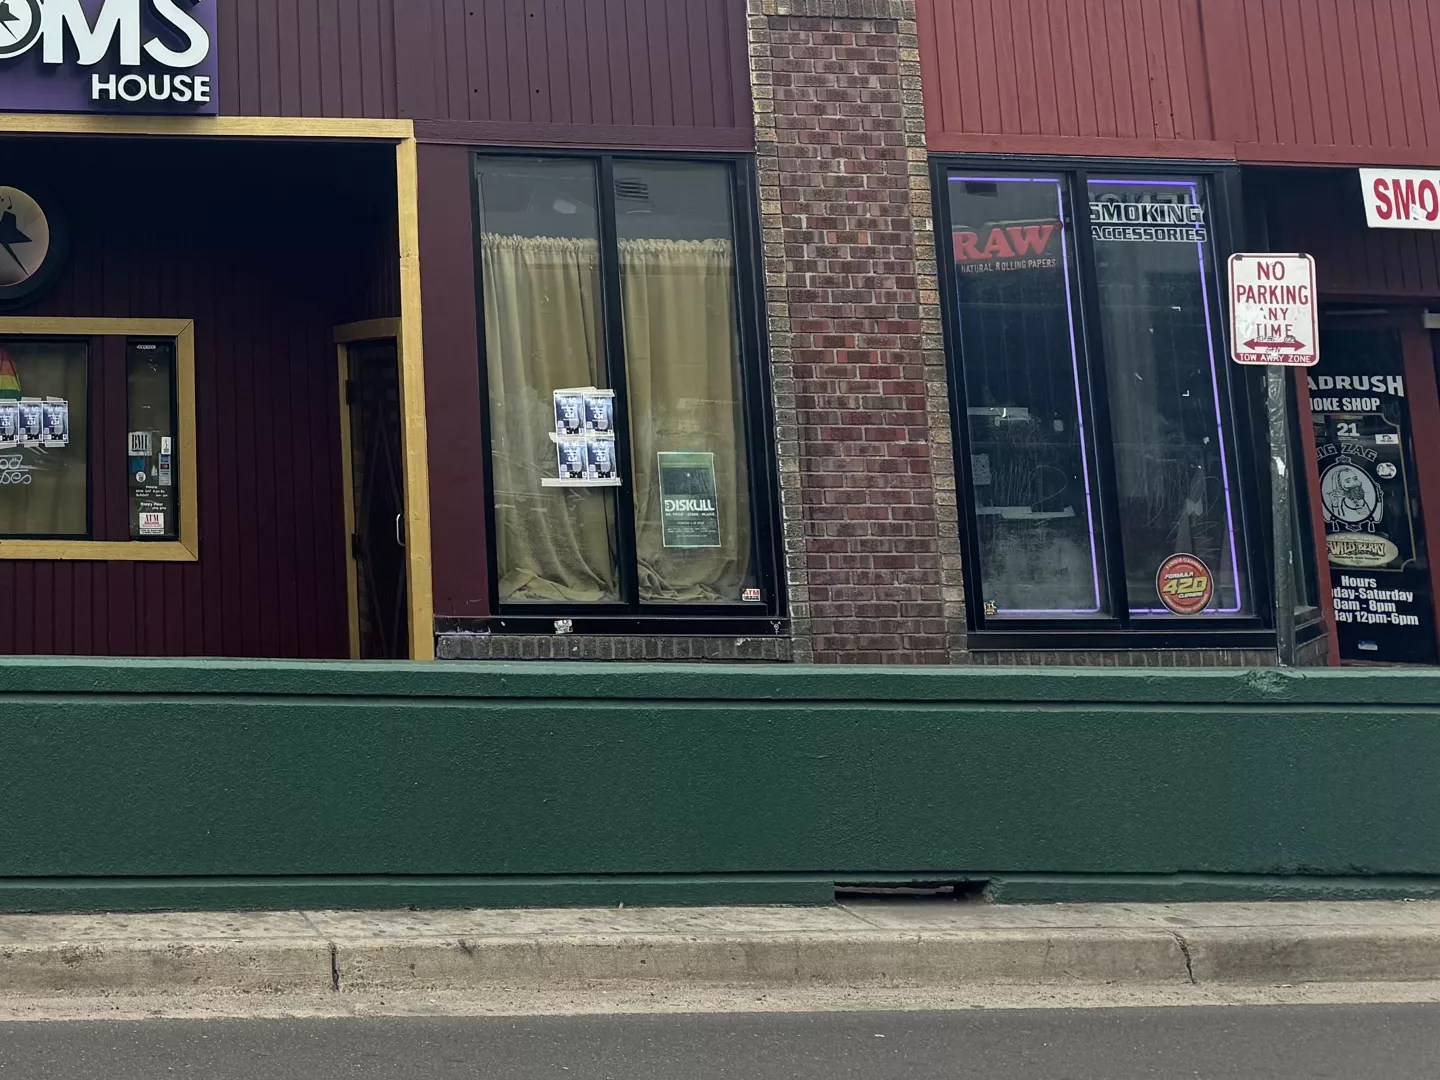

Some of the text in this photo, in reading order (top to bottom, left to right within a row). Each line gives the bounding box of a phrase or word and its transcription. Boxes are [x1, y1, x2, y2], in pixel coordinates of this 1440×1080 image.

[91, 73, 210, 103] HOUSE
[1373, 177, 1440, 222] SMO
[1089, 202, 1205, 225] SMOKING
[953, 224, 1055, 261] RAW
[1091, 225, 1208, 243] ACCESSORIES
[961, 258, 1057, 273] NATURAL ROLLING PAPERS
[1257, 261, 1285, 281] NO
[1236, 284, 1309, 305] PARKING
[1240, 353, 1257, 361] TOW
[1288, 355, 1312, 363] ZONE
[1310, 397, 1380, 412] OKE SHOP
[1336, 422, 1360, 437] 21
[1341, 442, 1378, 462] ZAG
[664, 499, 715, 512] DISKULL
[1326, 541, 1386, 558] WILD BERRY
[1162, 576, 1208, 595] 420
[1341, 575, 1378, 588] Hours
[1369, 599, 1397, 613] 8pm
[1354, 611, 1420, 626] 12pm-6pm
